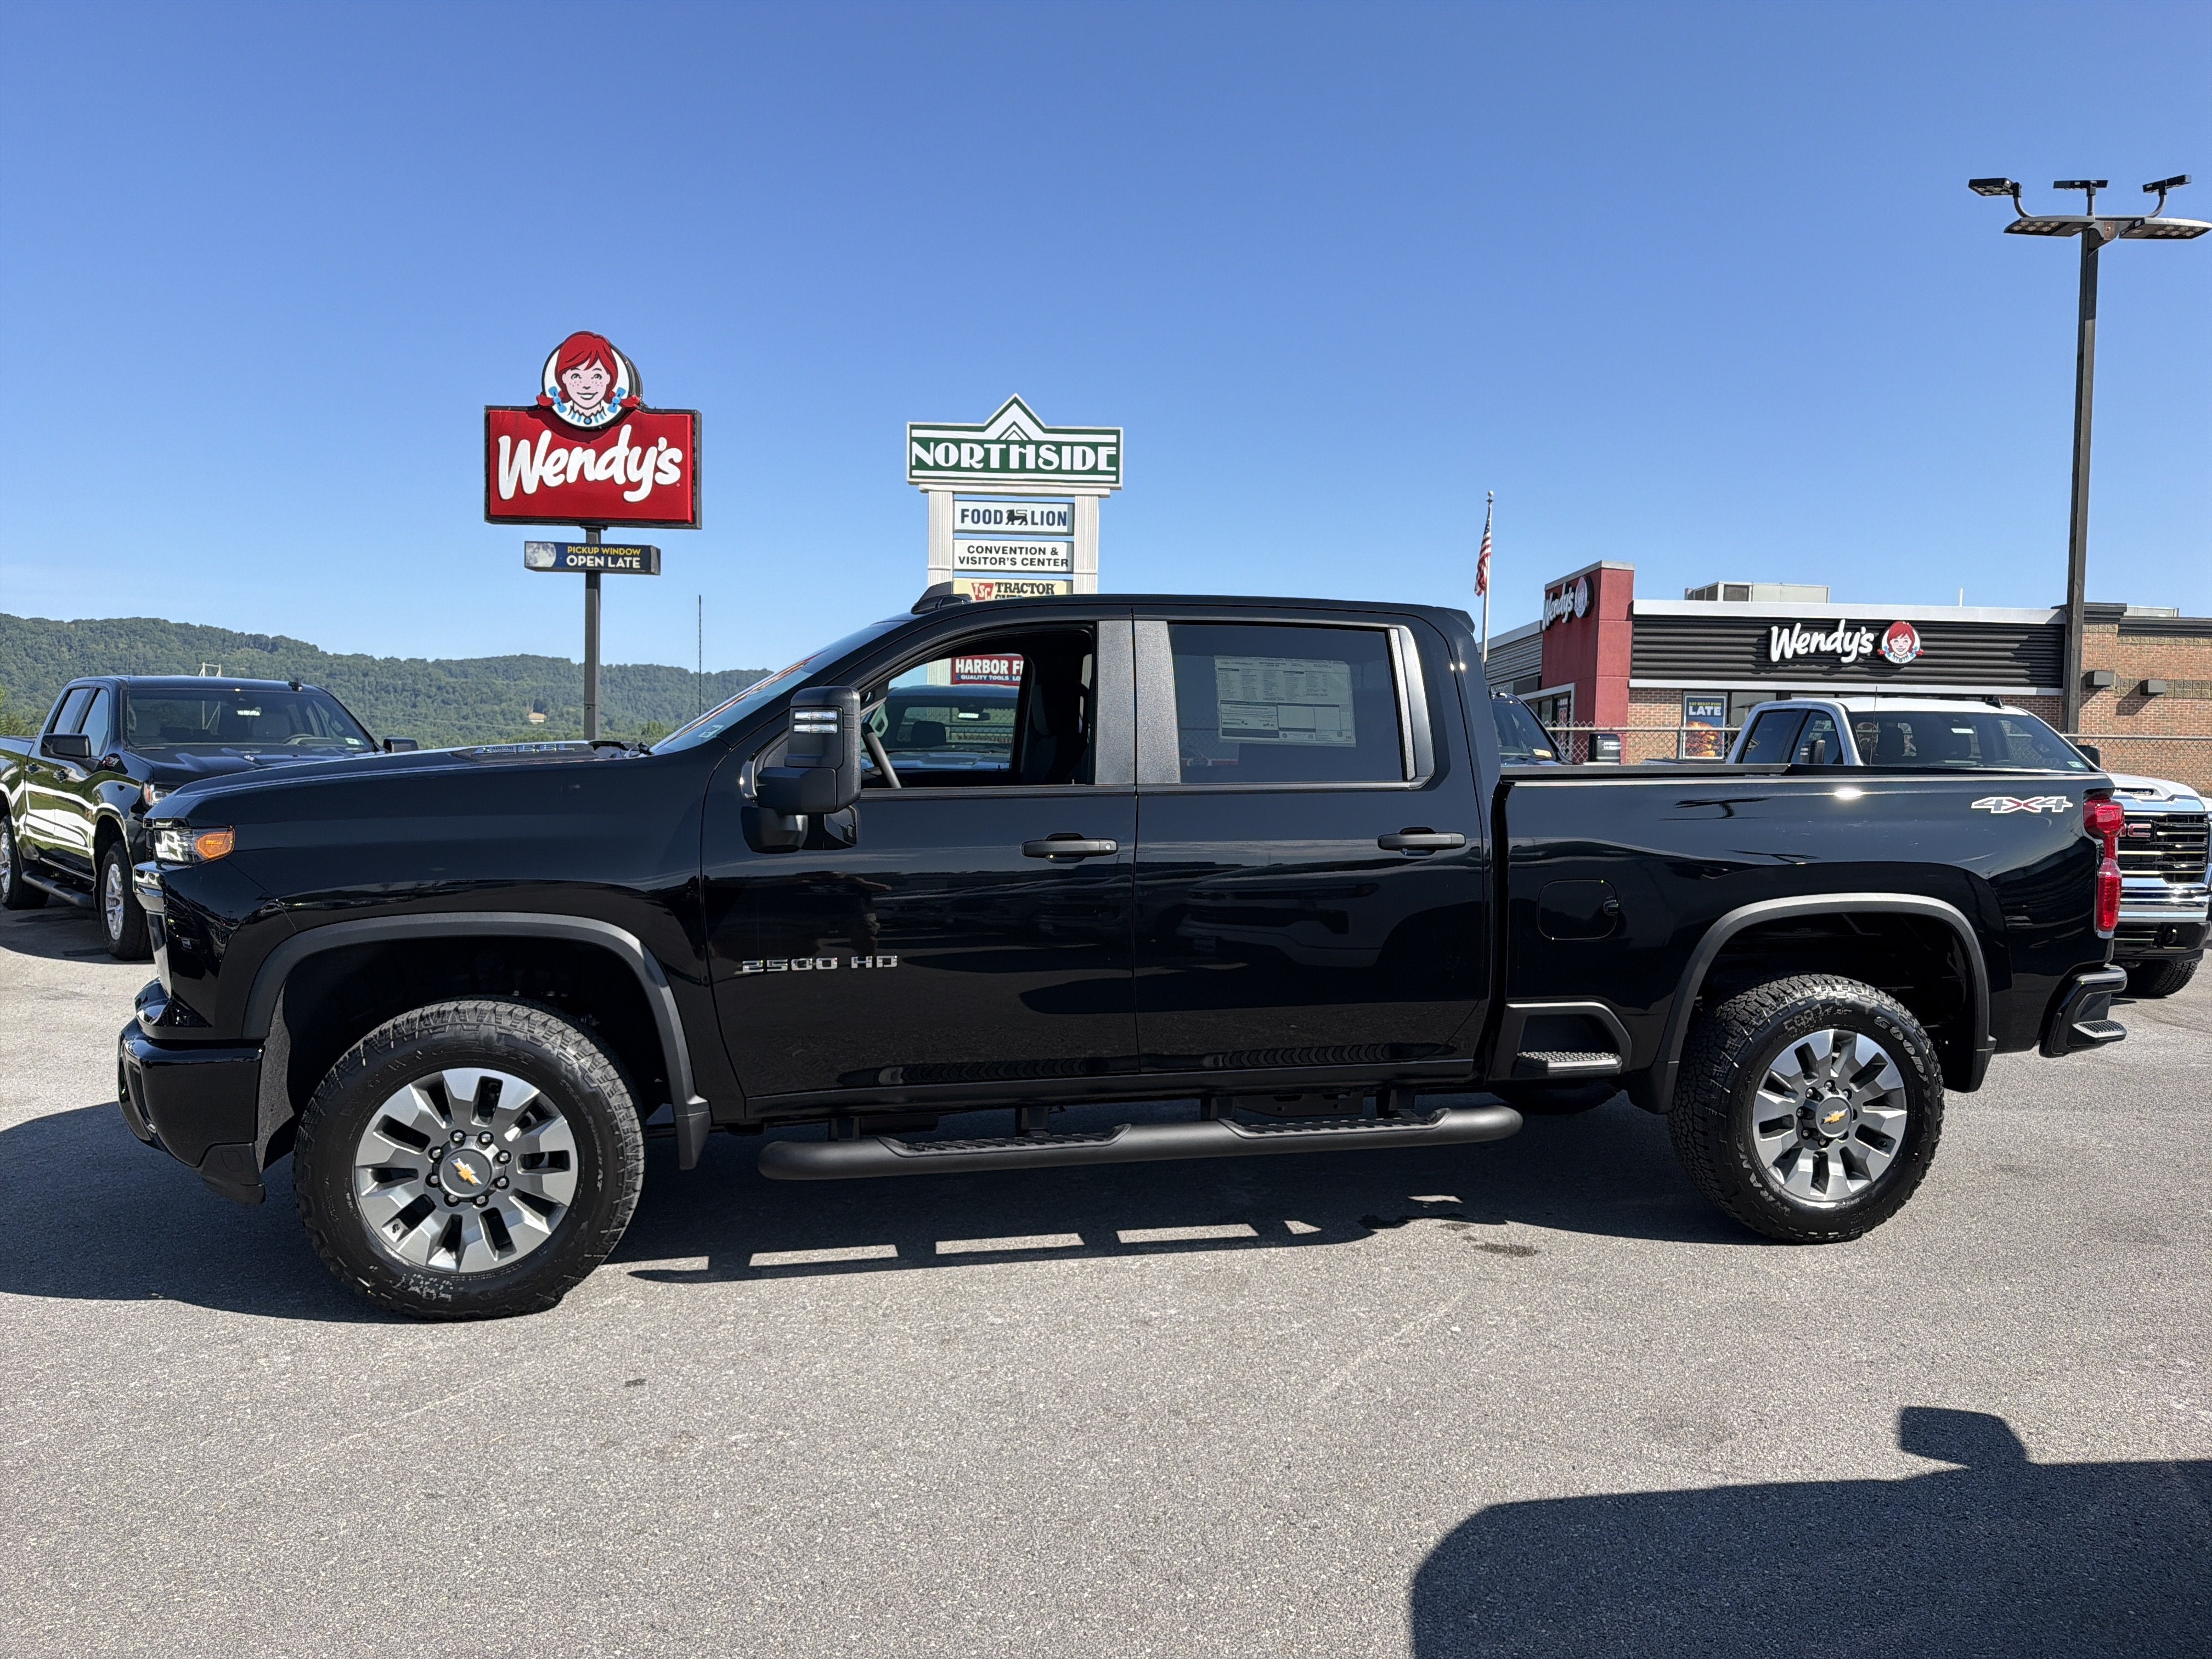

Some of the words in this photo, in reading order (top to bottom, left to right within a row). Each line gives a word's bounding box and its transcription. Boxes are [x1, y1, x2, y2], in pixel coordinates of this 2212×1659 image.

[498, 424, 682, 502] Wendy's
[911, 441, 1117, 471] NORTHSIDE
[961, 508, 1003, 525] FOOD
[1030, 510, 1068, 527] LION
[567, 546, 600, 554] PICKUP
[601, 548, 641, 556] WINDOW
[967, 545, 1046, 556] CONVENTION
[1050, 547, 1059, 556] &
[566, 555, 604, 567] OPEN
[608, 556, 641, 568] LATE
[958, 556, 1017, 566] VISITOR'S
[1020, 557, 1069, 567] CENTER
[973, 583, 991, 600] TSC
[995, 582, 1055, 595] TRACTOR
[1770, 619, 1875, 663] Wendy's
[955, 658, 1009, 675] HARBOR
[1689, 706, 1722, 716] LATE
[742, 957, 838, 973] 2500
[851, 955, 898, 969] HD
